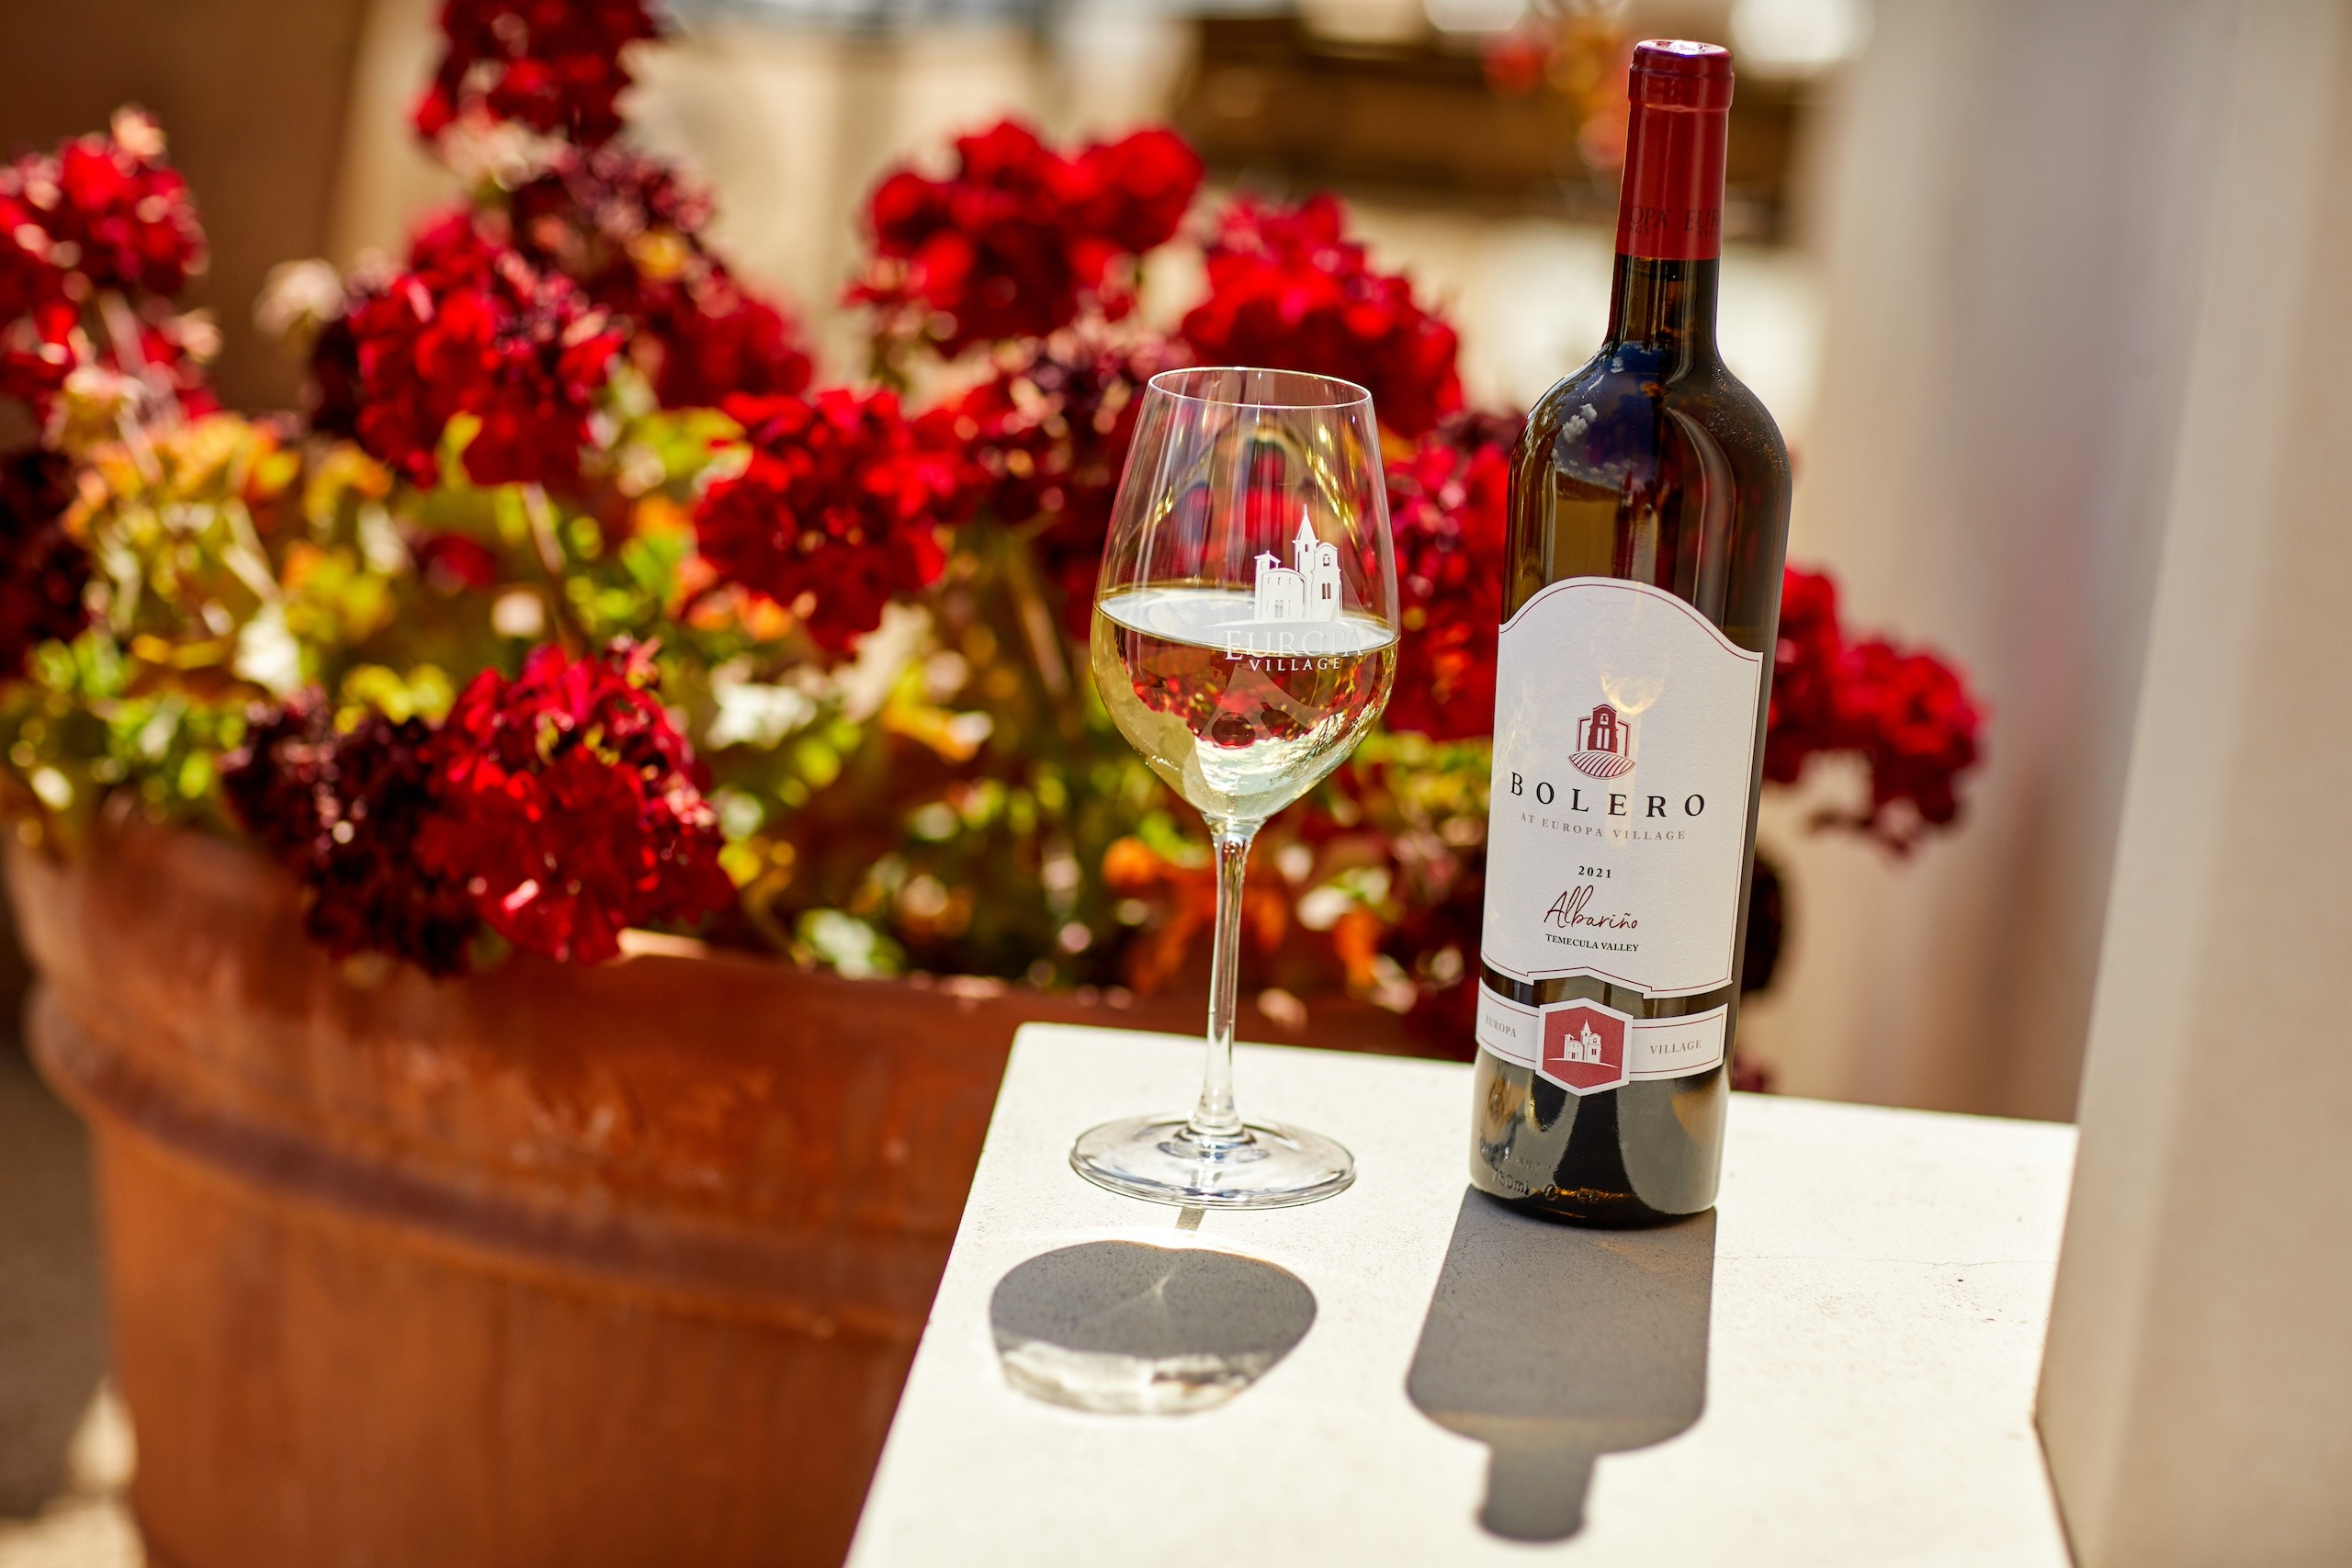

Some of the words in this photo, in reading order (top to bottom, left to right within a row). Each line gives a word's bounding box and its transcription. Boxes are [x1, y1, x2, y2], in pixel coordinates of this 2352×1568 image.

[1225, 626, 1364, 660] EUROPA
[1249, 657, 1340, 671] VILLAGE
[1510, 772, 1706, 818] BOLERO
[1521, 812, 1535, 823] AT
[1542, 818, 1603, 837] EUROPA
[1612, 829, 1687, 840] VILLAGE
[1577, 865, 1612, 879] 2021
[1544, 885, 1638, 930] Albariño
[1545, 933, 1600, 950] TEMECULA
[1600, 942, 1640, 952] VALLEY
[1485, 1013, 1518, 1038] EUROPA
[1649, 1038, 1702, 1055] VILLAGE
